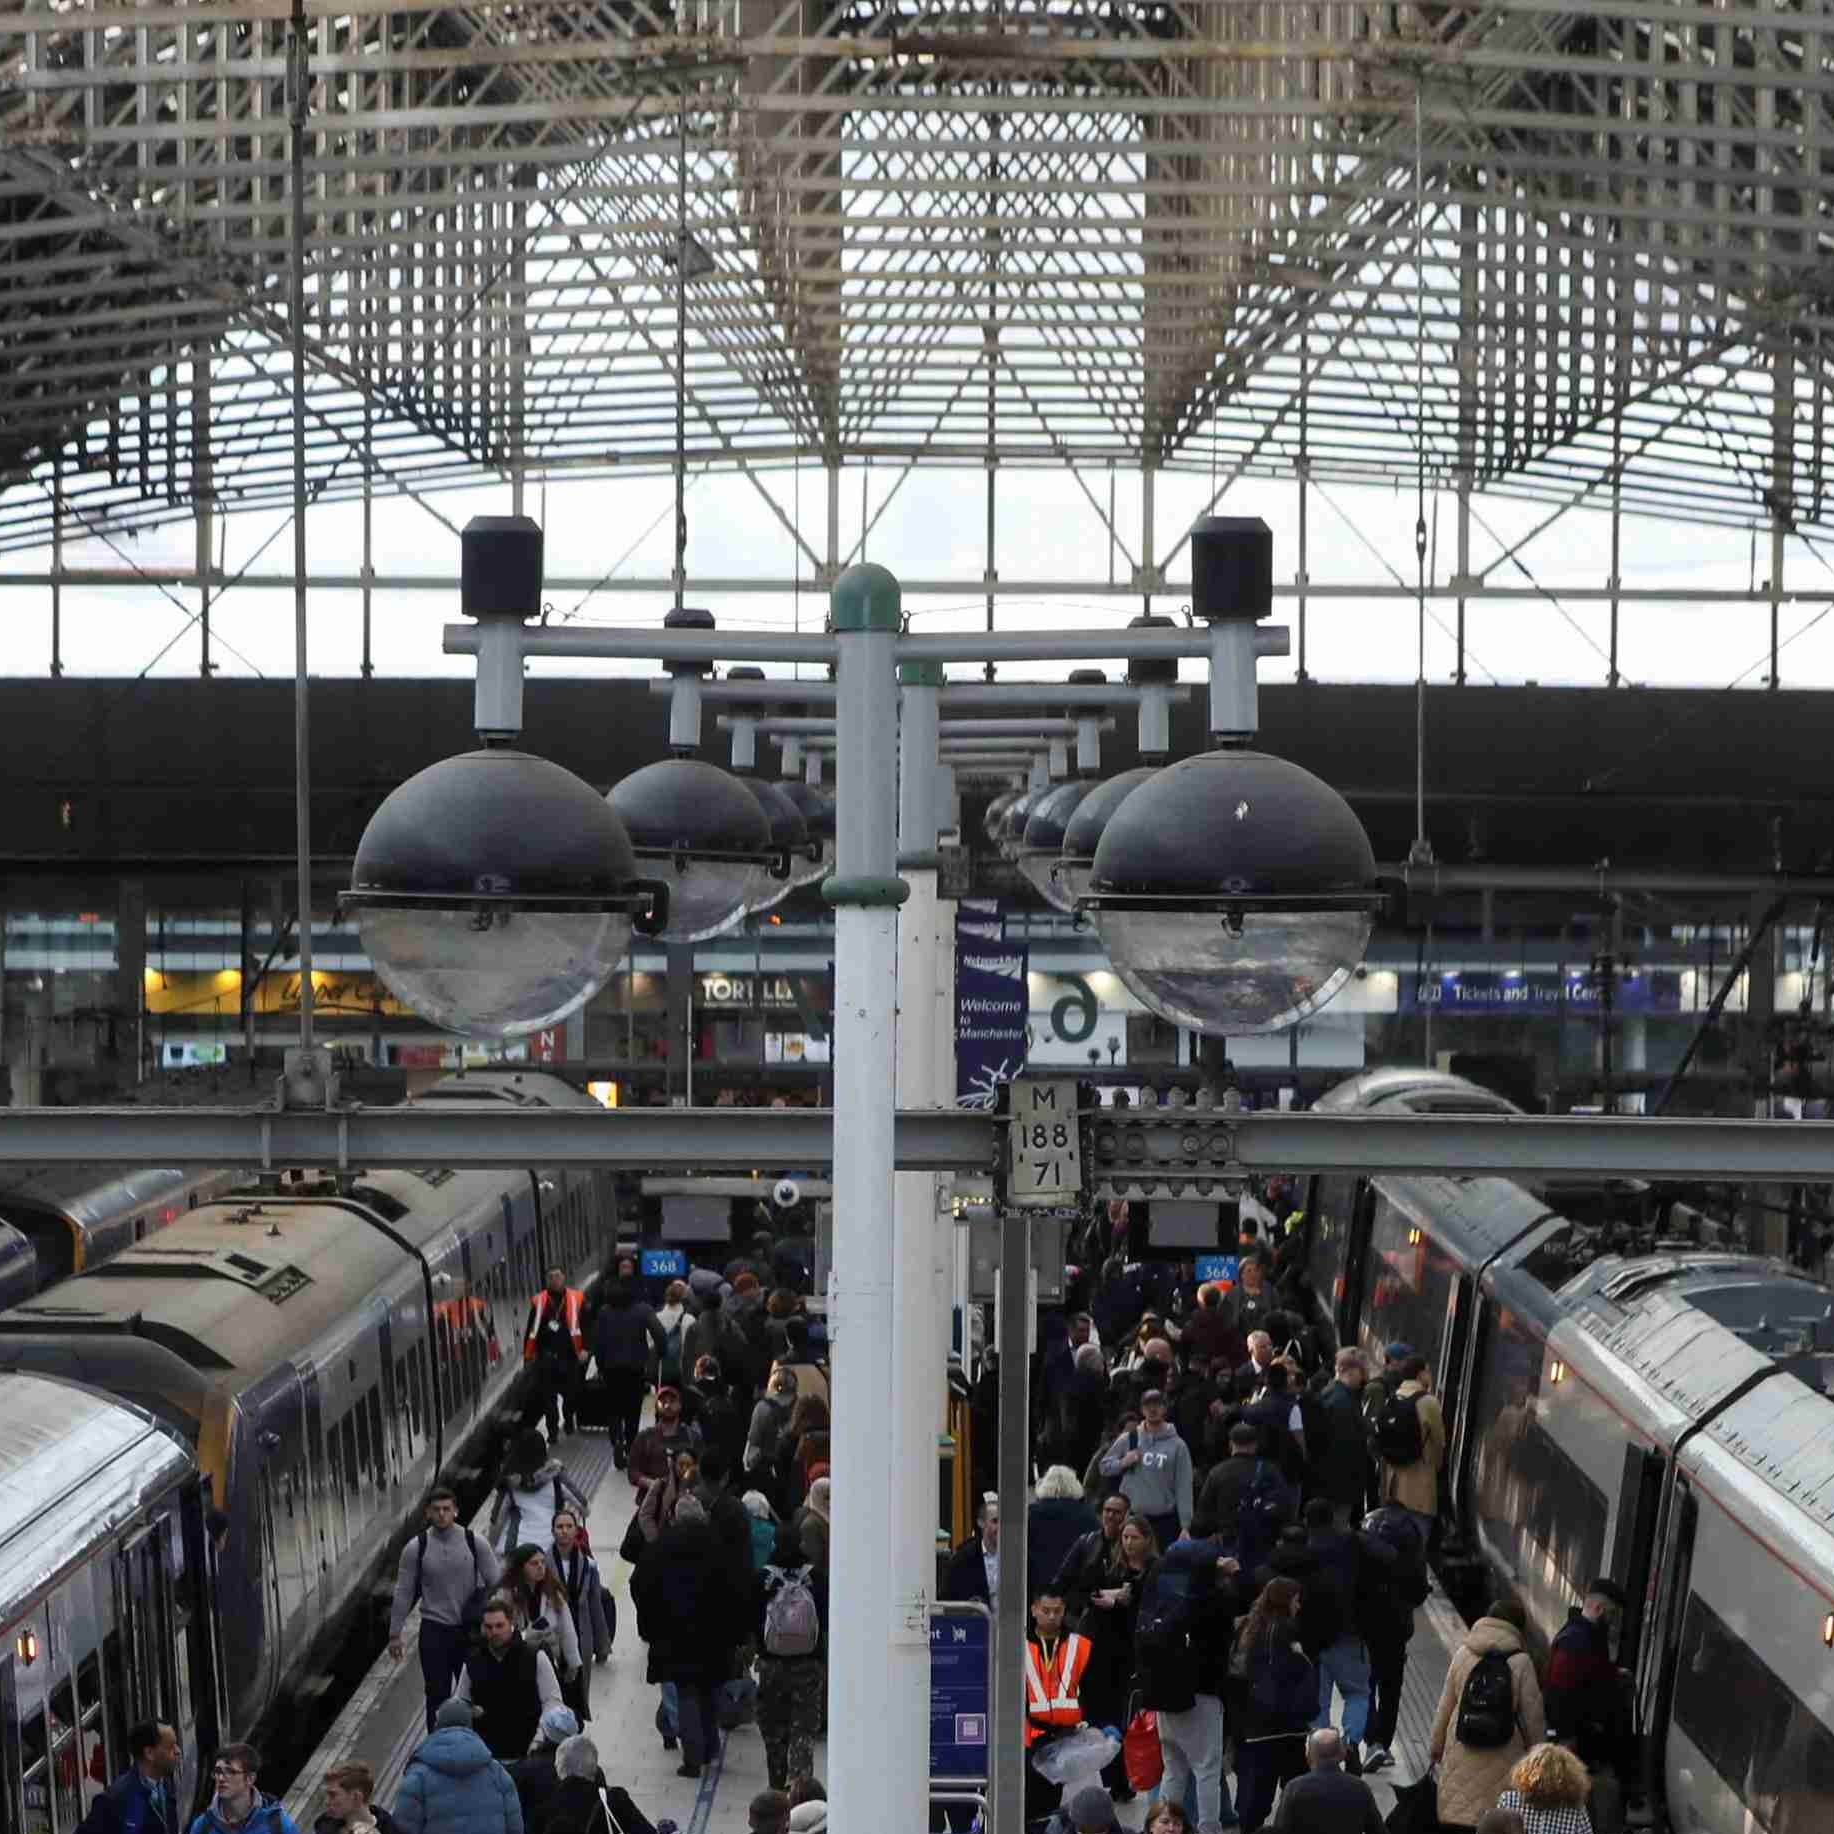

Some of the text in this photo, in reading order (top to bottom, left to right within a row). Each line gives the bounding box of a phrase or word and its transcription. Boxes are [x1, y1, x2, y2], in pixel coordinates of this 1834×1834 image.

[1503, 984, 1528, 1001] and
[960, 998, 1021, 1013] Welcome
[959, 1015, 971, 1025] to
[959, 1027, 1023, 1041] Manchester
[1032, 1089, 1056, 1110] M
[1021, 1124, 1068, 1149] 188
[1034, 1162, 1061, 1186] 71
